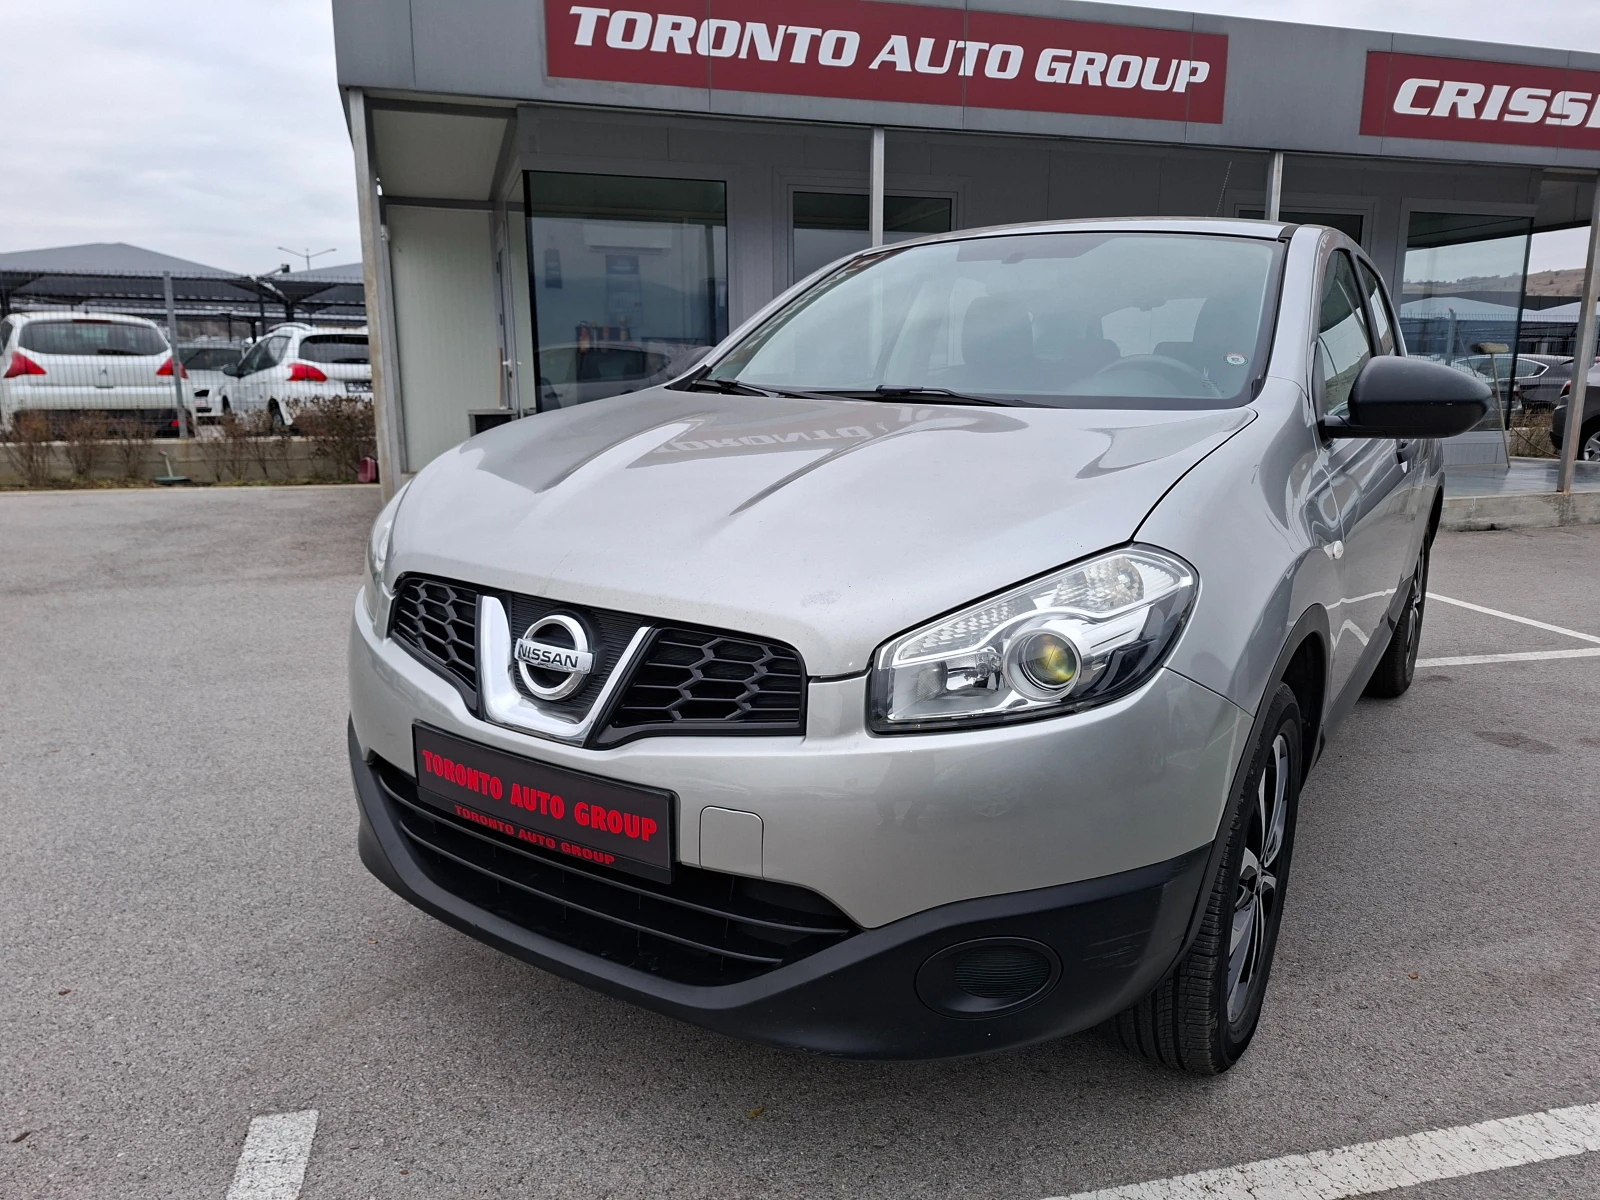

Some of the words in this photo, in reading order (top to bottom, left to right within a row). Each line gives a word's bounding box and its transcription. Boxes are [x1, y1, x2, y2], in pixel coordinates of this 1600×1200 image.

[569, 6, 861, 67] TORONTO
[868, 35, 1025, 80] AUTO
[1033, 48, 1211, 93] GROUP
[518, 643, 578, 668] NISSAN
[422, 749, 503, 800] TORONTO
[510, 783, 565, 820] AUTO
[574, 802, 658, 842] GROUP
[455, 805, 515, 835] TORONTO
[518, 828, 556, 850] AUTO
[561, 842, 616, 866] GROUP
